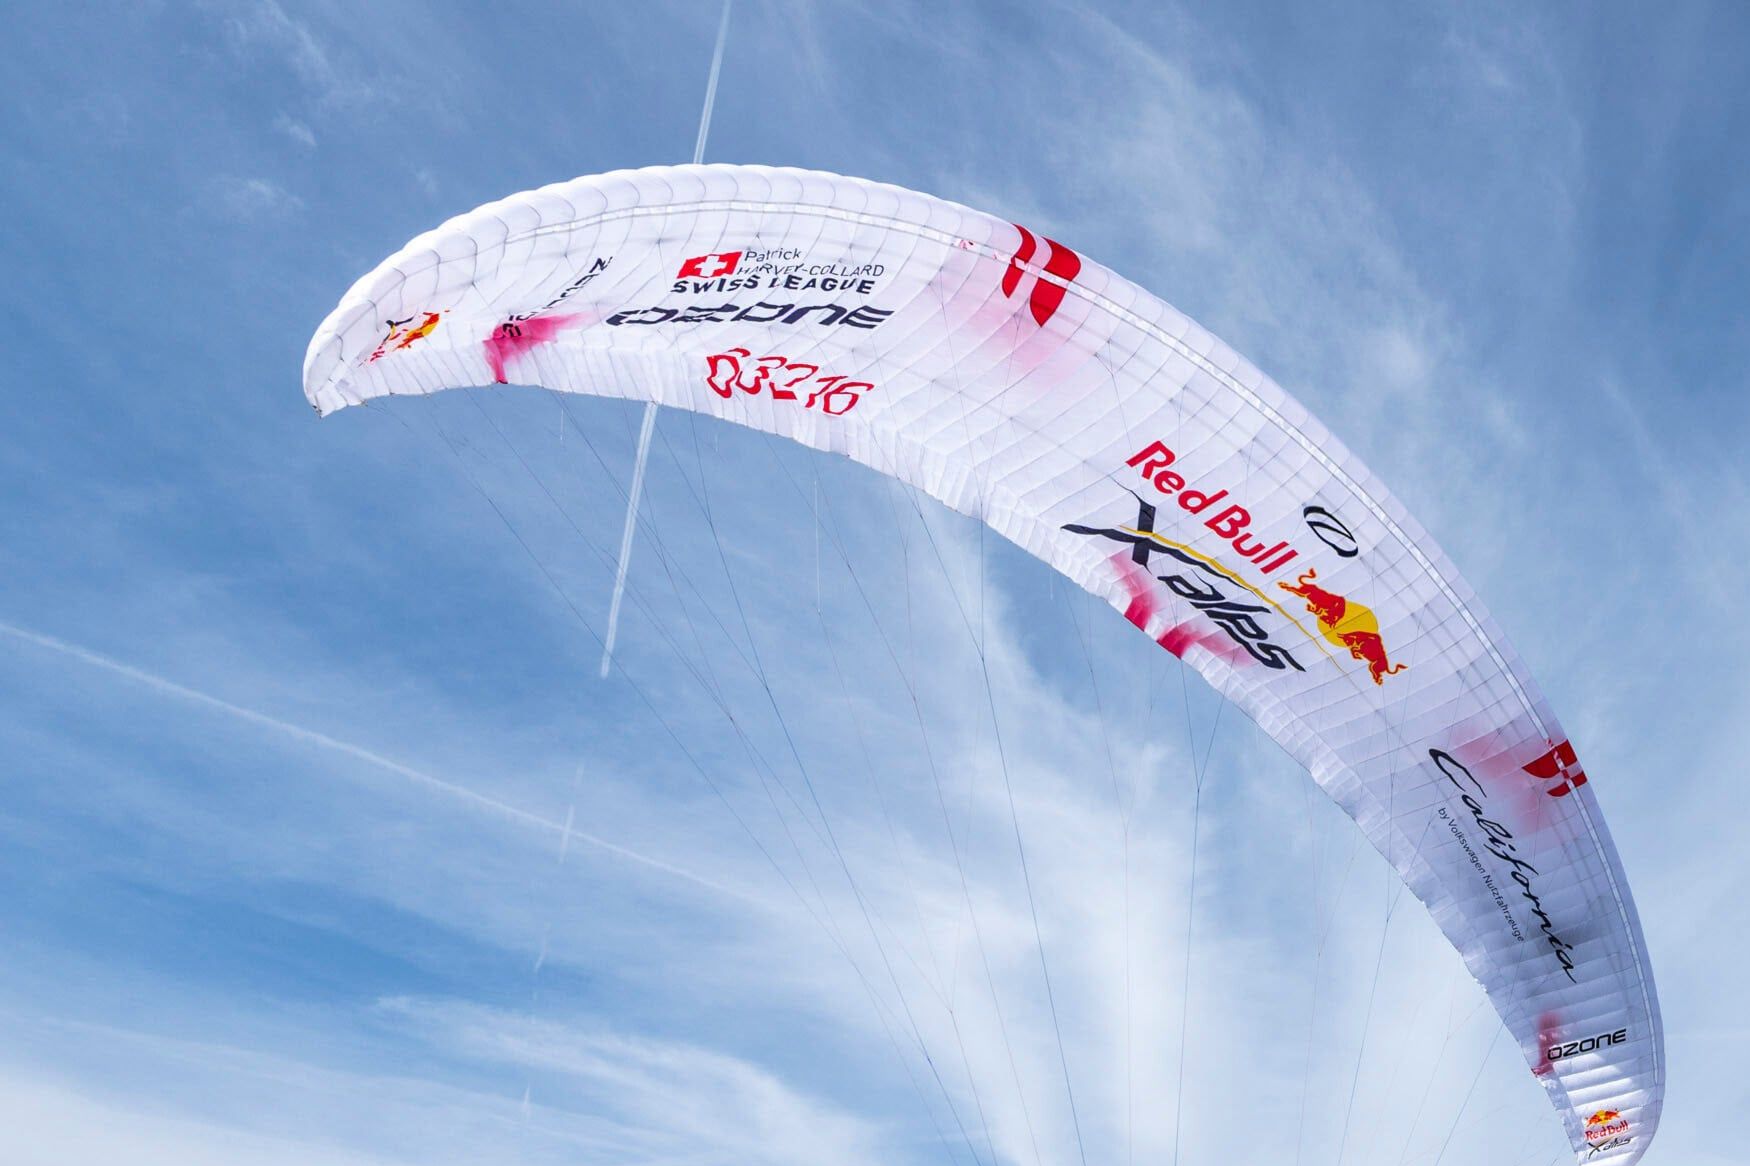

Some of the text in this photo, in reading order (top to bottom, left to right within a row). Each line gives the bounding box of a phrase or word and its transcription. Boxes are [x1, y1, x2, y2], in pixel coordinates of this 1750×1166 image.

[743, 247, 801, 263] Patrick
[670, 273, 876, 296] SWISS LEAGUE
[736, 263, 885, 278] HARVEY-COLLARD
[605, 301, 895, 330] OZONE
[1125, 440, 1299, 575] Red Bull
[1428, 748, 1578, 985] California
[1437, 807, 1525, 943] by Volkswagen Nutzfahrzeuge
[1547, 1028, 1627, 1061] OZONE
[1585, 1121, 1629, 1142] Red Bull
